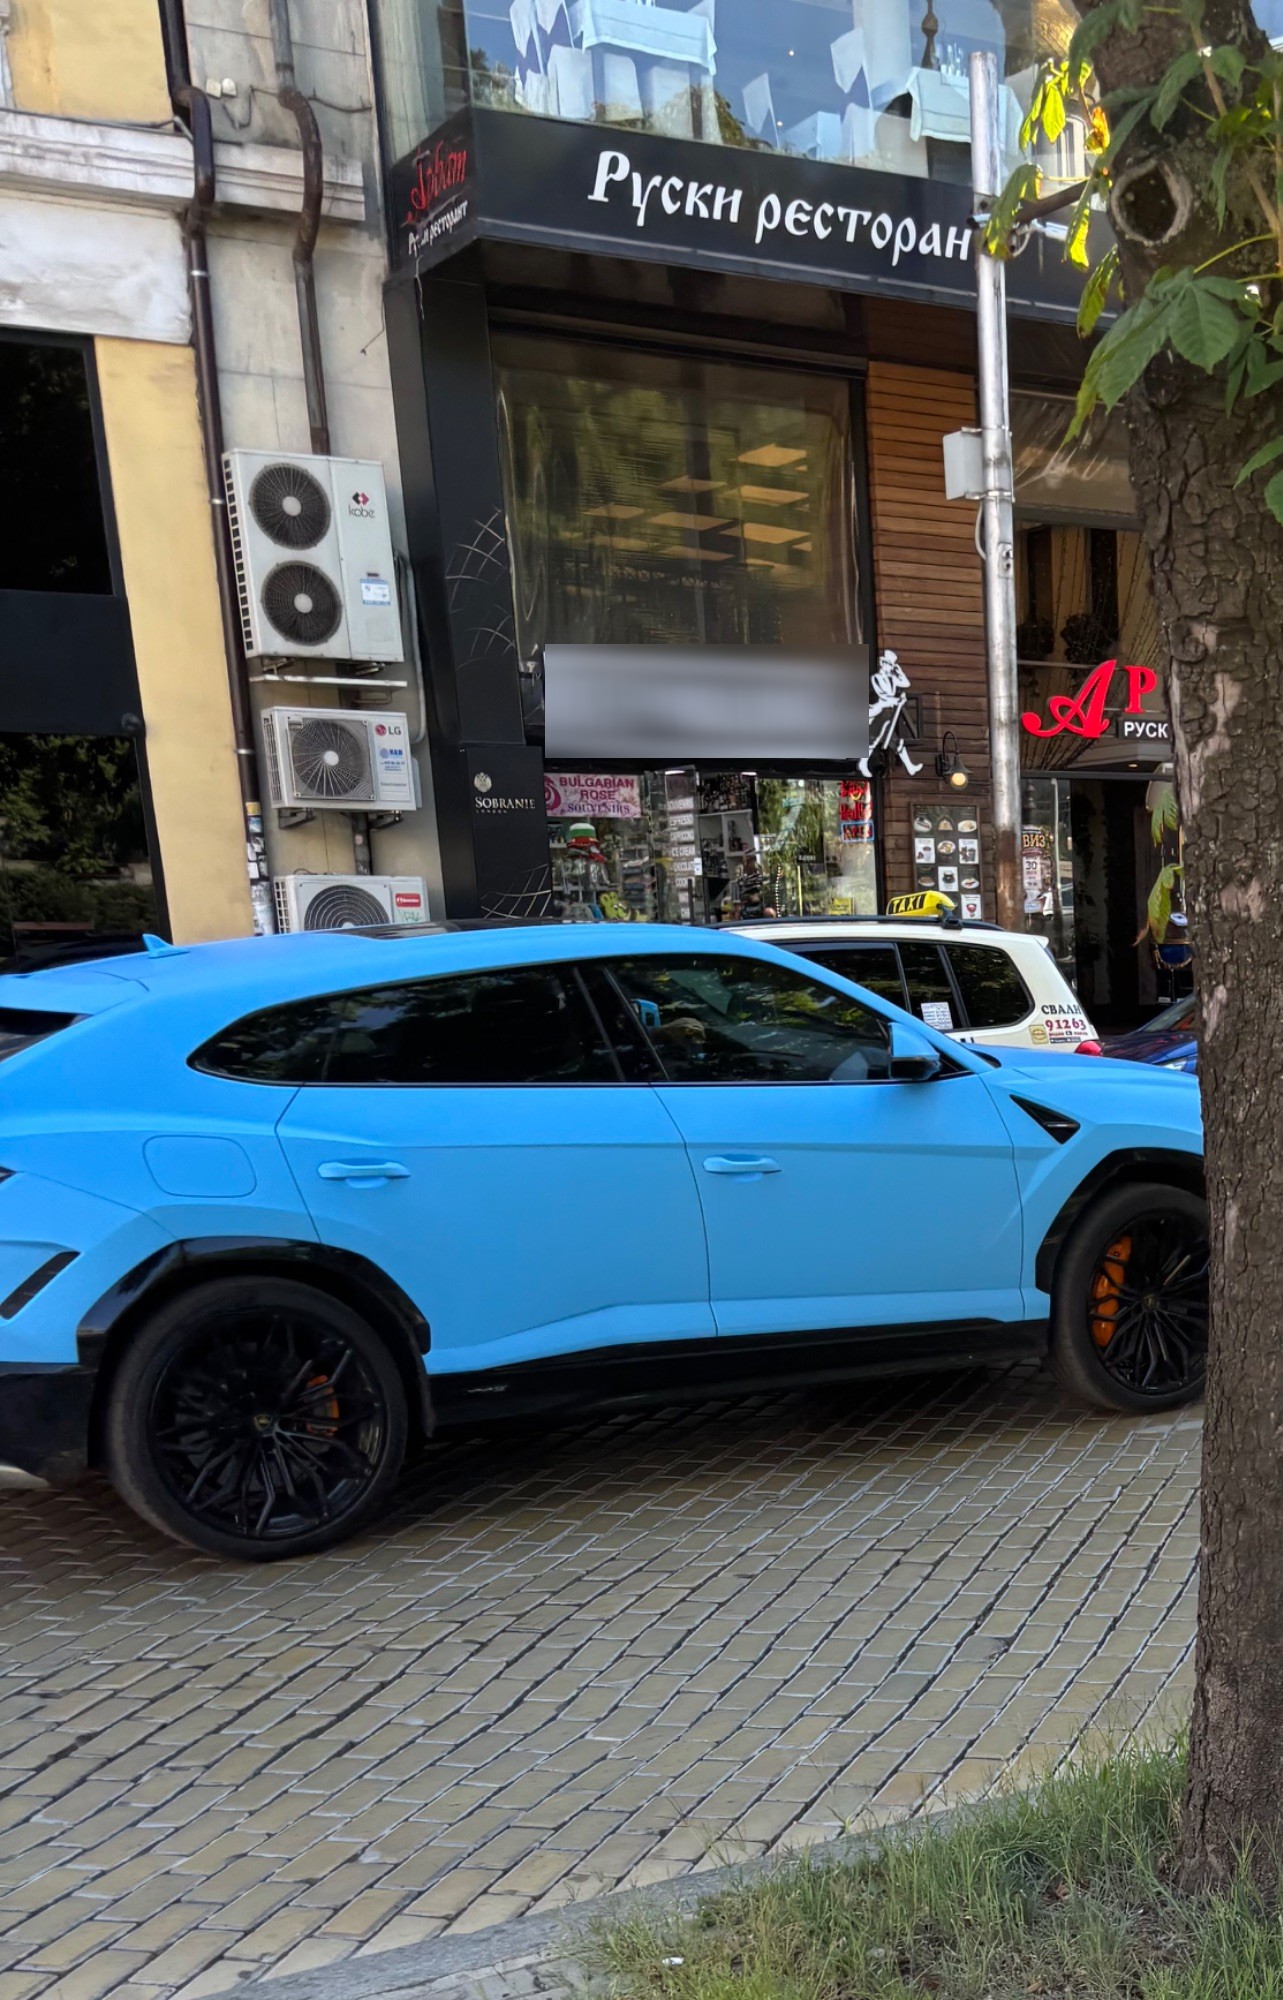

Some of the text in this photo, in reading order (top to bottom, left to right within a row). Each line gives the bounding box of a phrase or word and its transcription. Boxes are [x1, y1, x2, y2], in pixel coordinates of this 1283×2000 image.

[587, 150, 973, 267] Руски ресторан
[348, 505, 375, 518] kobe
[1021, 659, 1157, 738] АР
[388, 726, 402, 736] LG
[1124, 721, 1169, 738] РУСК
[559, 776, 635, 790] BULGARIAN
[580, 789, 616, 800] ROSE
[475, 797, 536, 809] SOBRANIE
[893, 895, 922, 914] TAXI
[1045, 1018, 1086, 1031] 91263
